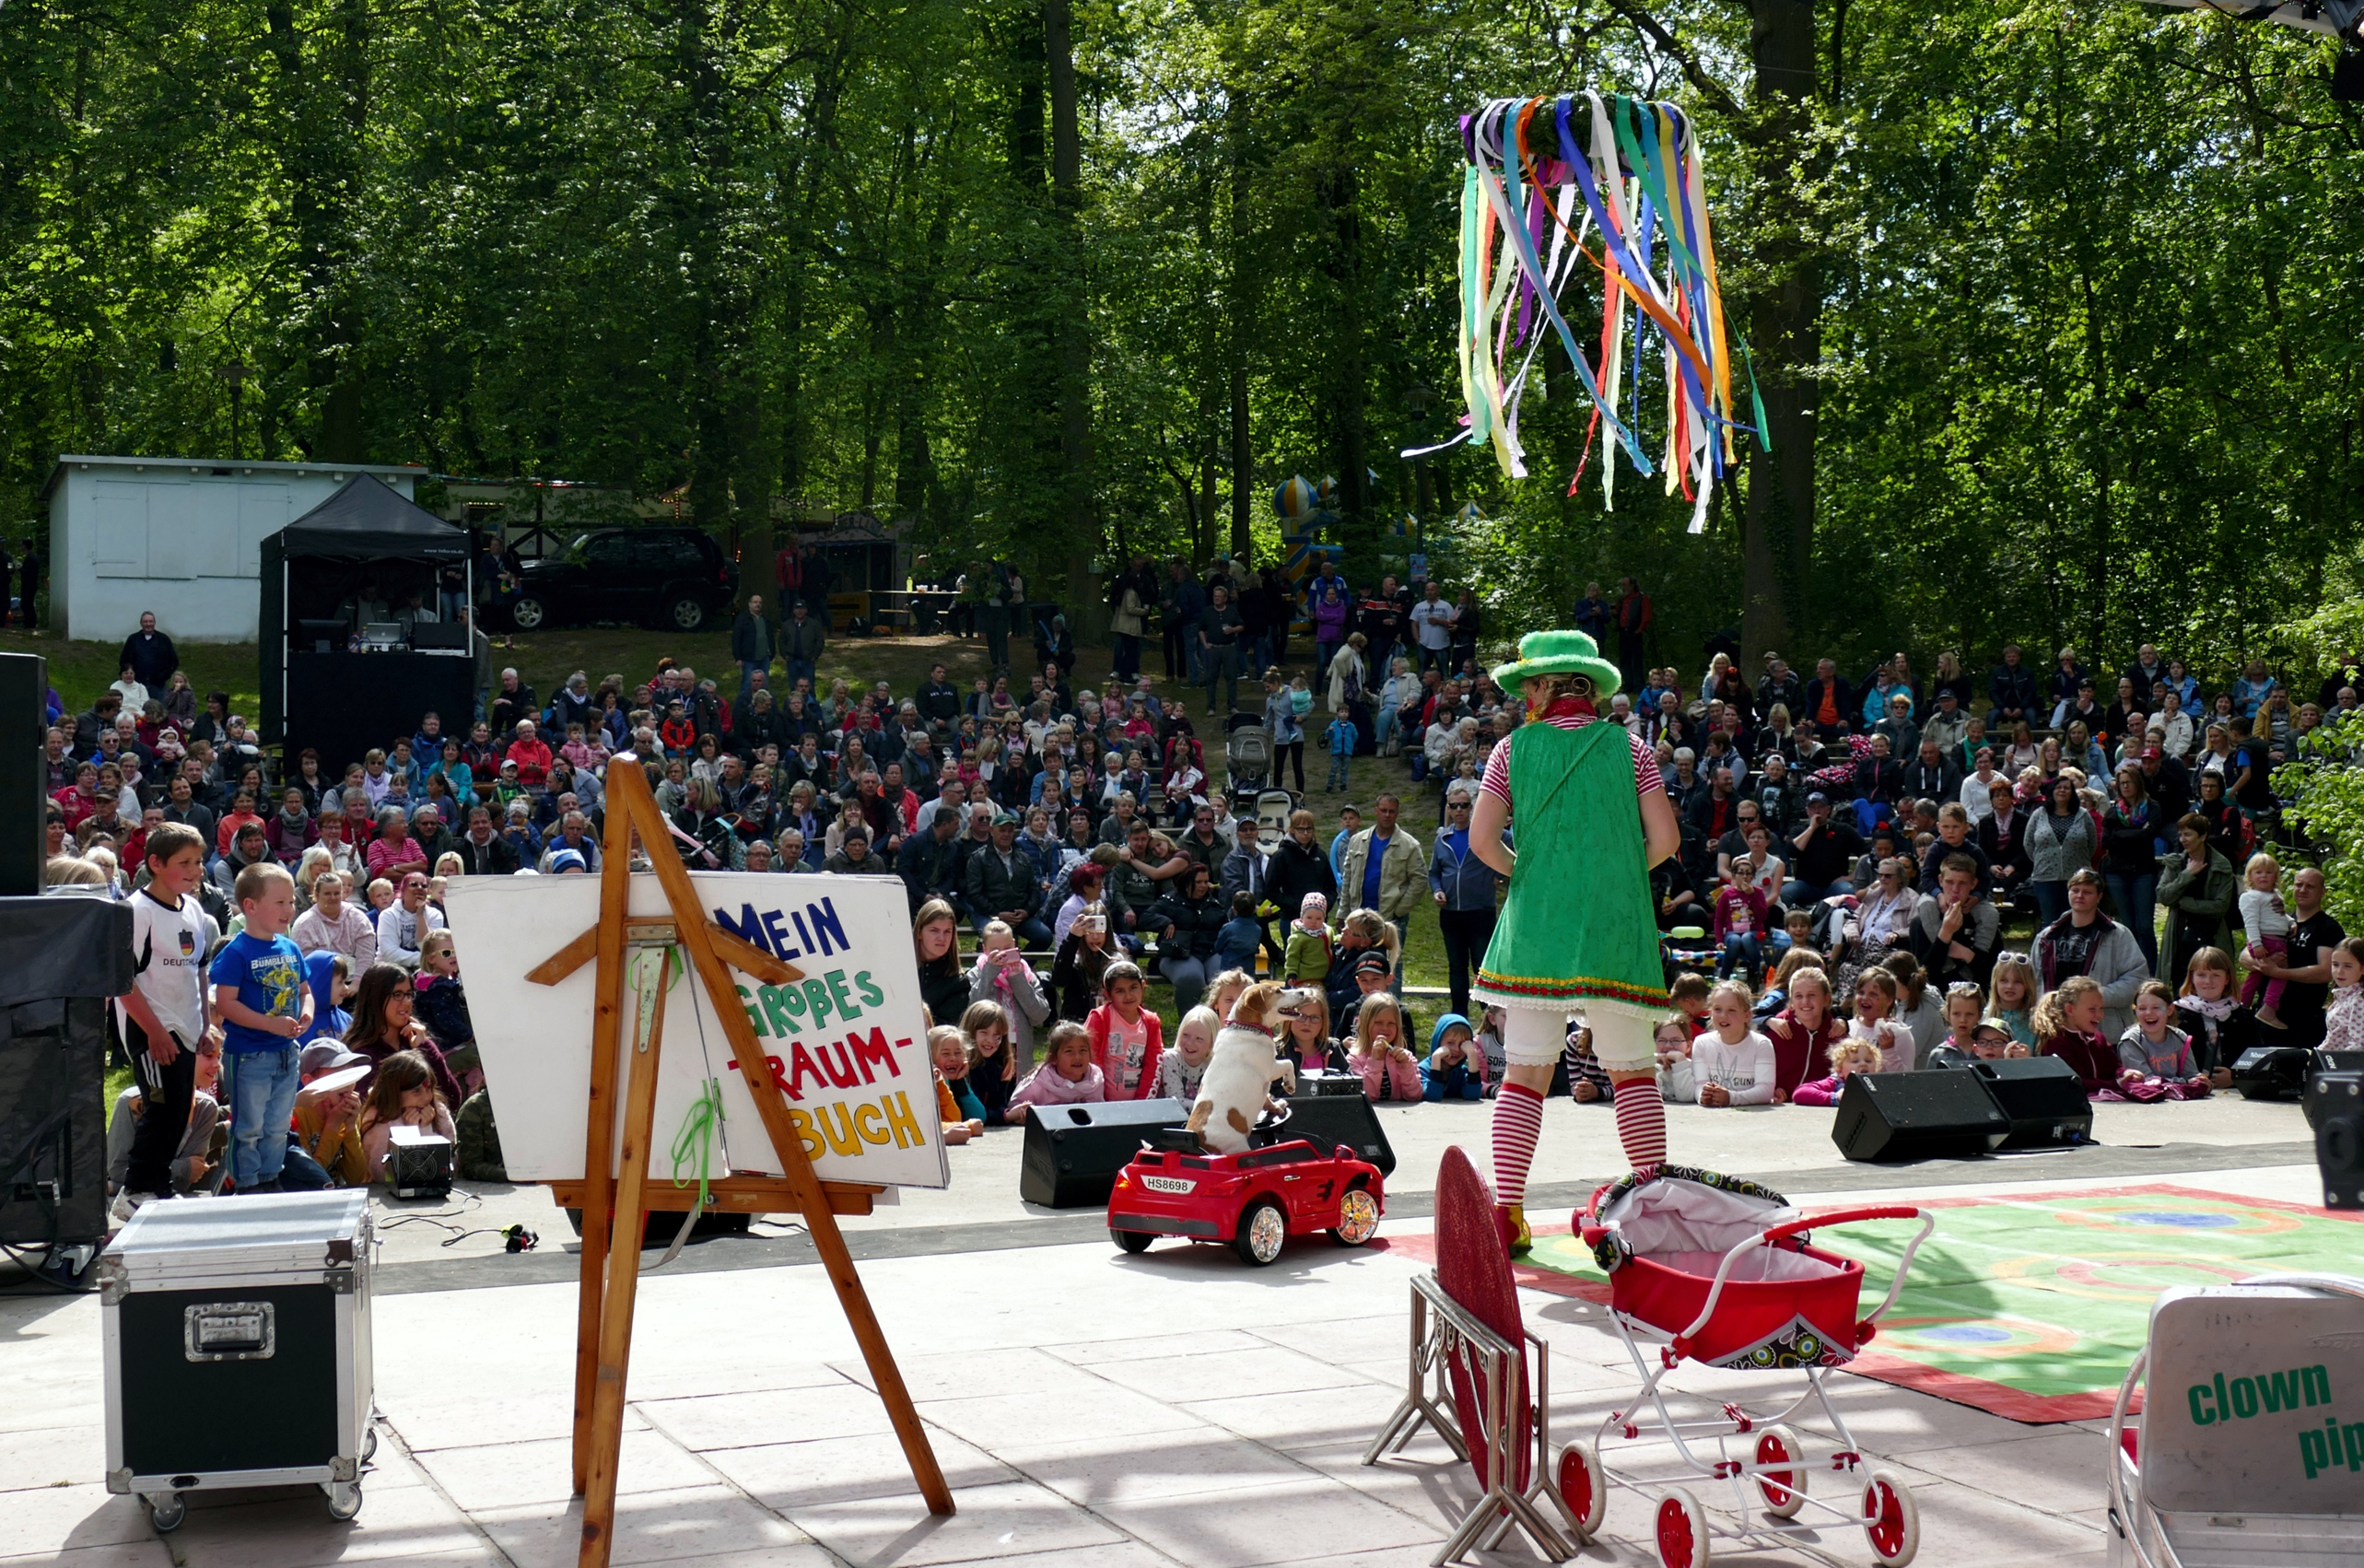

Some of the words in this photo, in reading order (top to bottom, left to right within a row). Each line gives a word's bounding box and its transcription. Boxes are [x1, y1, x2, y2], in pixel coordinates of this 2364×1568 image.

[713, 896, 850, 962] MEIN
[251, 954, 298, 970] BUMBLEBEE
[787, 1091, 926, 1162] BUCH
[1148, 1178, 1188, 1191] HS8698
[2187, 1364, 2333, 1426] clown
